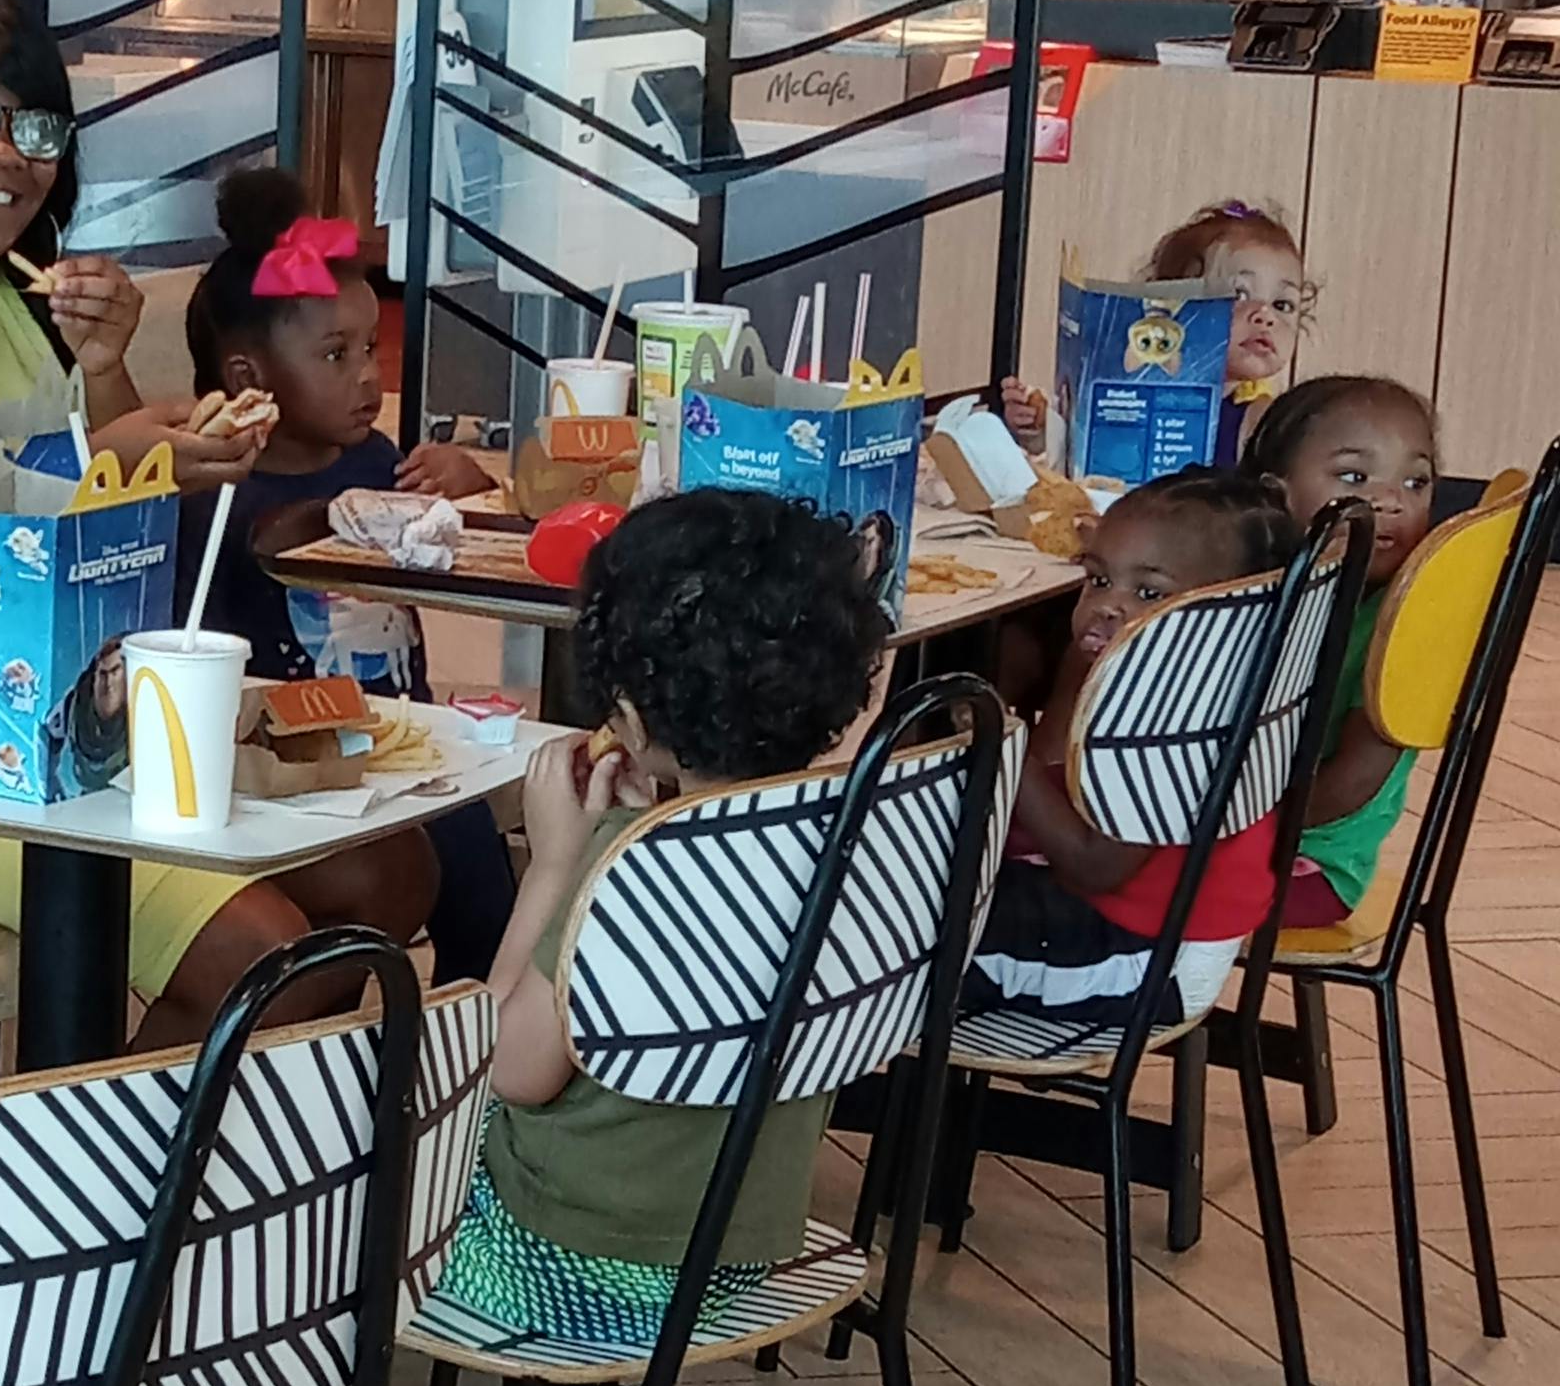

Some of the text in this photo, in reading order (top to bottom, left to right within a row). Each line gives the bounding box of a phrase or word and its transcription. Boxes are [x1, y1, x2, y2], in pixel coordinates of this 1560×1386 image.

[1385, 13, 1476, 30] Food Allergy?
[758, 452, 780, 466] off
[732, 461, 780, 481] beyond
